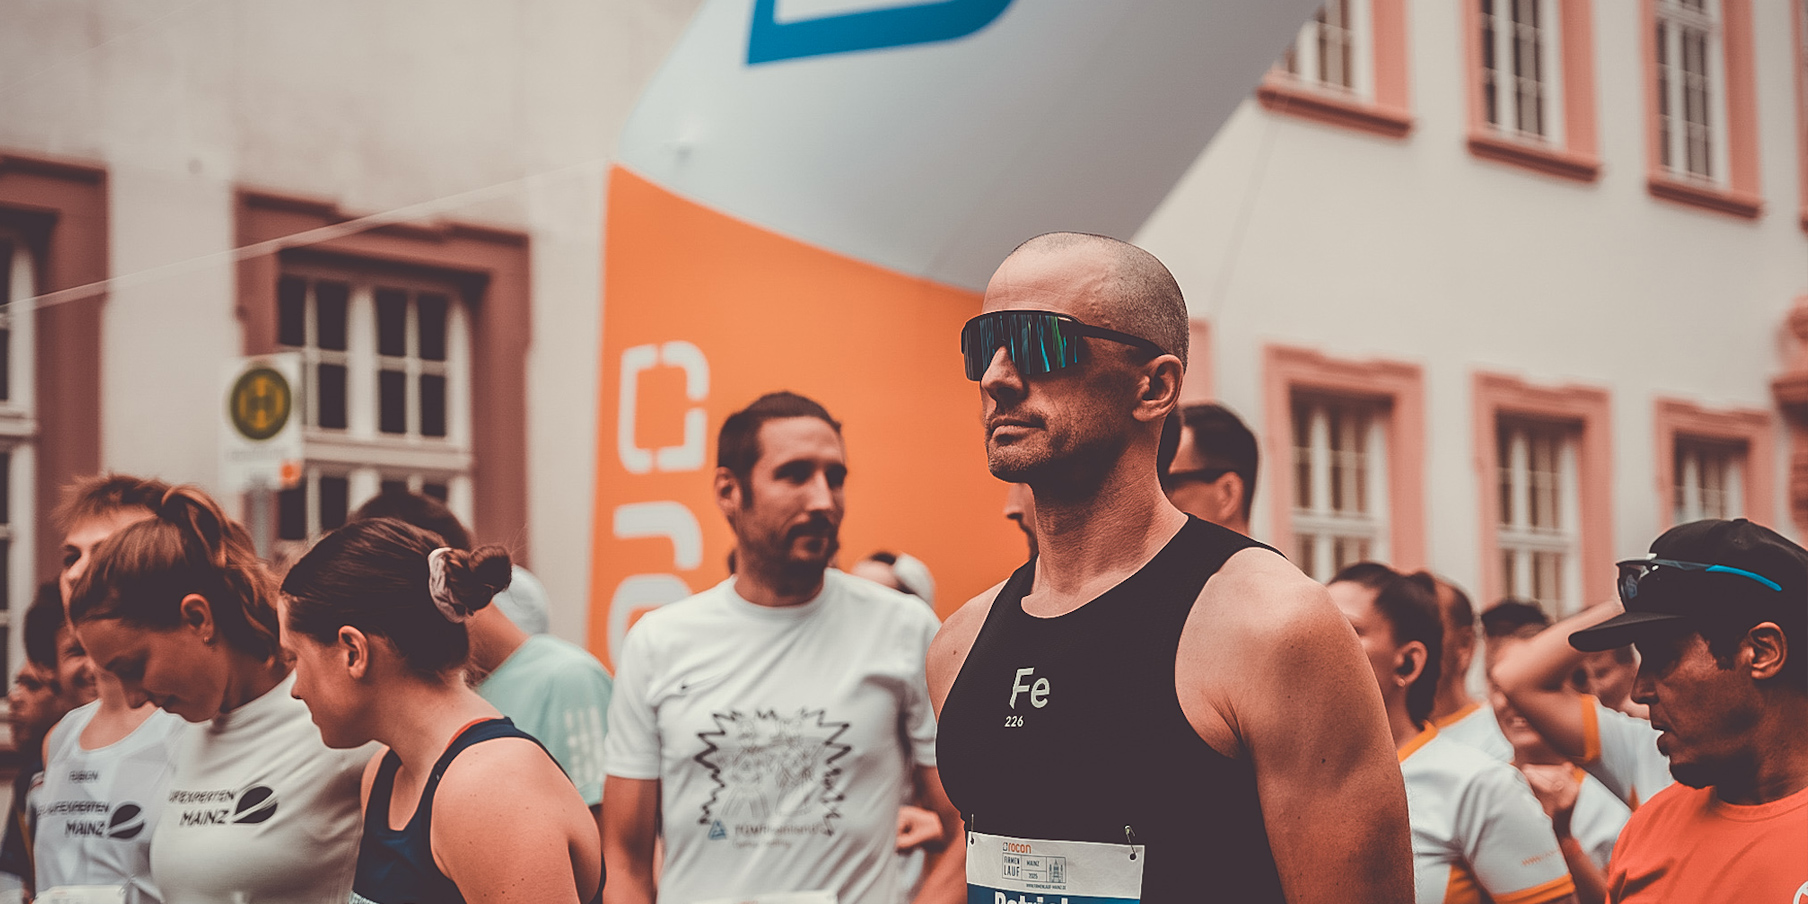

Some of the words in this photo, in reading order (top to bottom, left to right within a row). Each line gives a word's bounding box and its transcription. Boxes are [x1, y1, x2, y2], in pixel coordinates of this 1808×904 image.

[1009, 667, 1050, 709] Fe
[1004, 715, 1024, 728] 226
[179, 808, 230, 827] MAINZ
[65, 819, 106, 837] MAINZ
[1008, 842, 1032, 854] rocon
[1004, 855, 1020, 865] FIRMEN
[1026, 859, 1040, 867] MAINZ
[1004, 865, 1020, 877] LAUF
